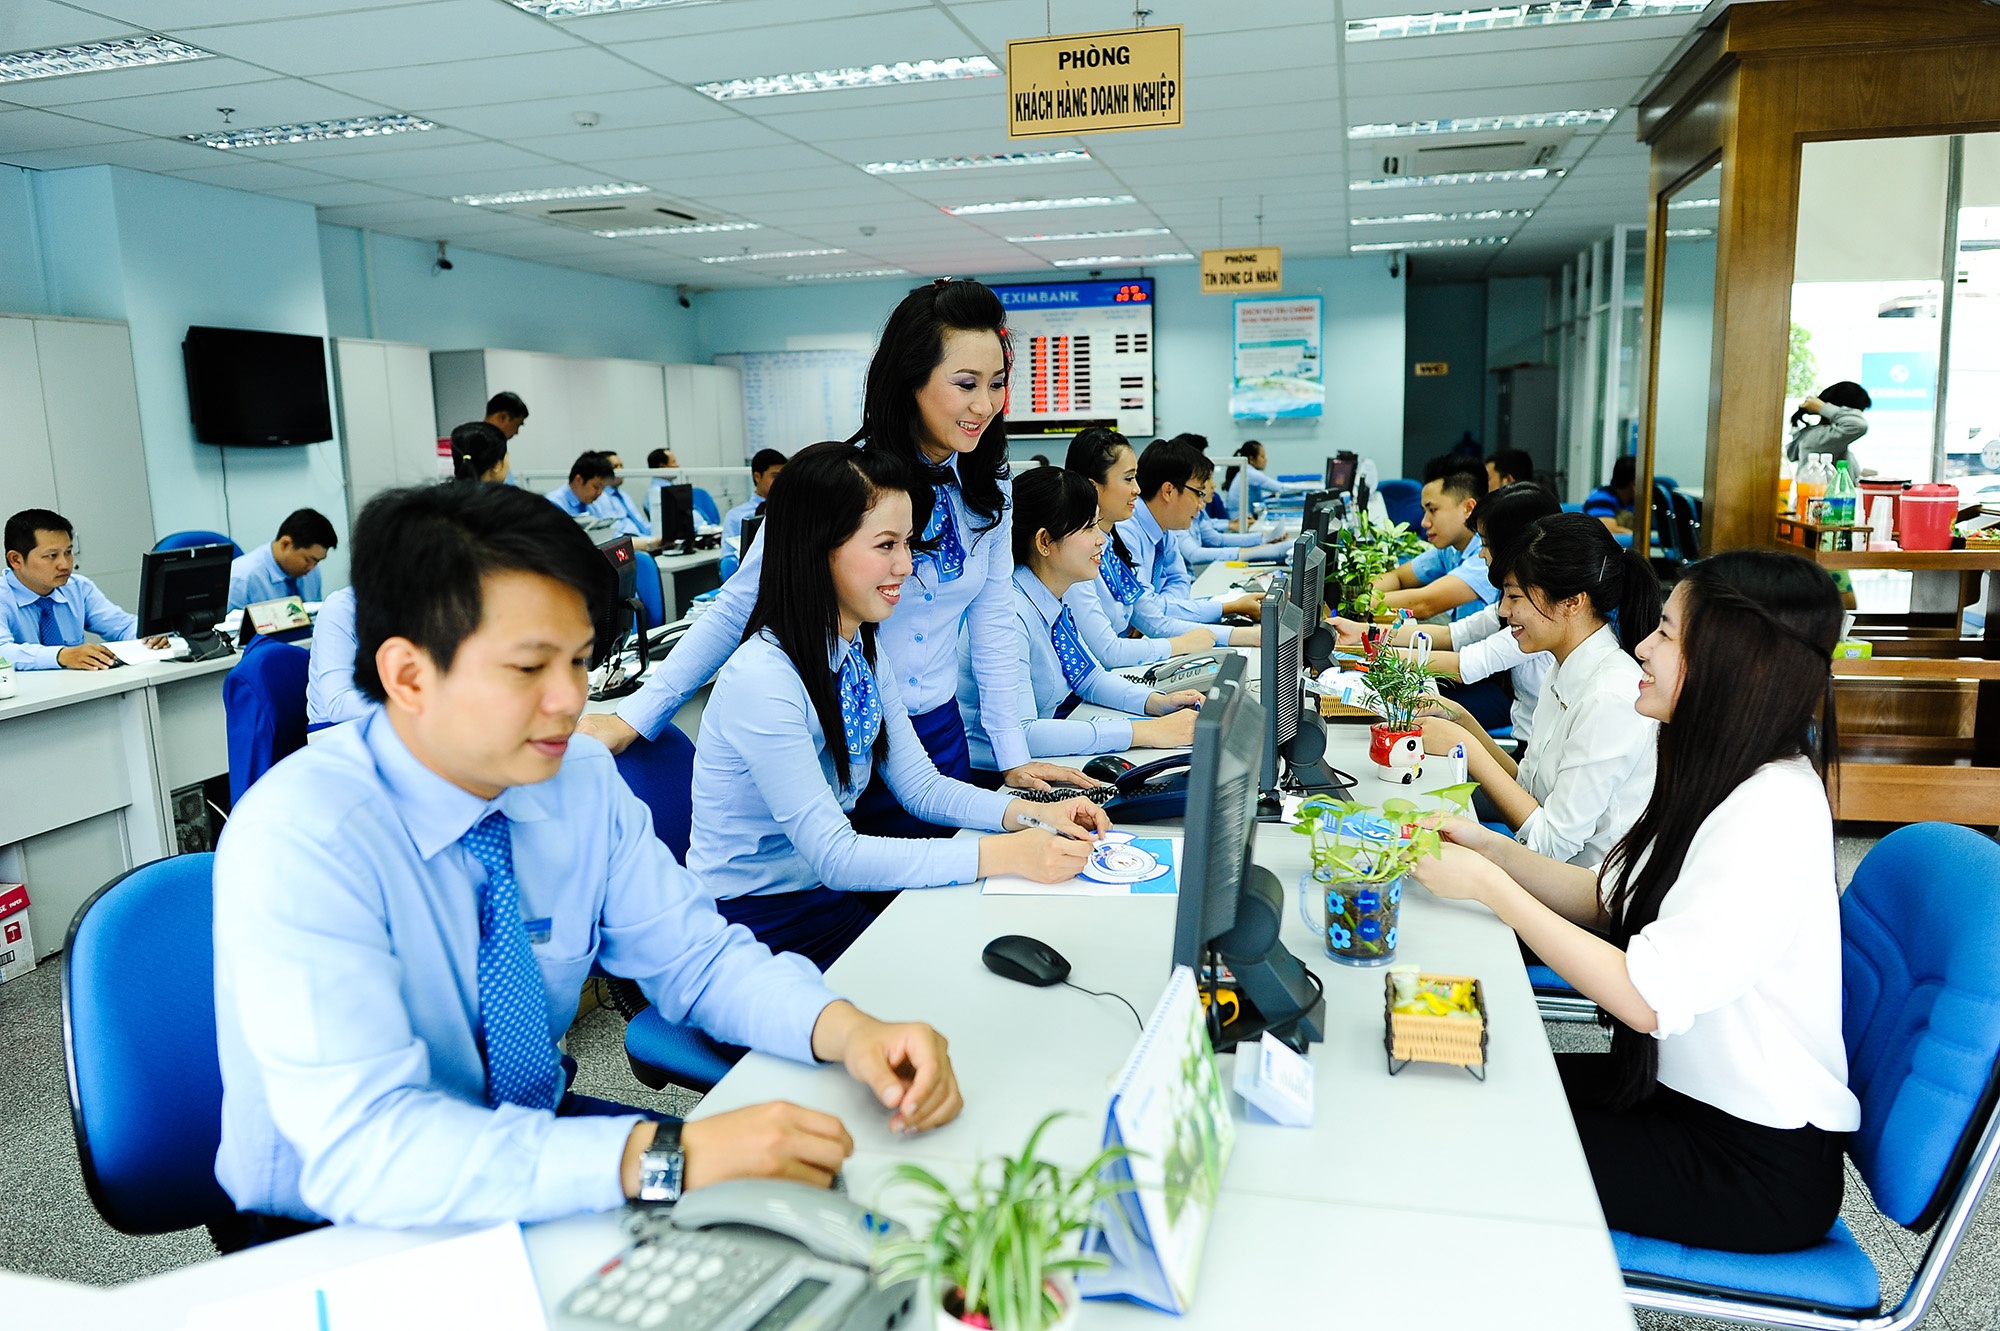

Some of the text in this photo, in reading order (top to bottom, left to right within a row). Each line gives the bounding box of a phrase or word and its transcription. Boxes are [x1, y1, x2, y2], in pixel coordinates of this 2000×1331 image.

[1058, 43, 1131, 70] PHÒNG
[1015, 72, 1176, 122] KHÁCH HÀNG DOANH NGHIỆP
[1001, 291, 1080, 305] EXIMBANK
